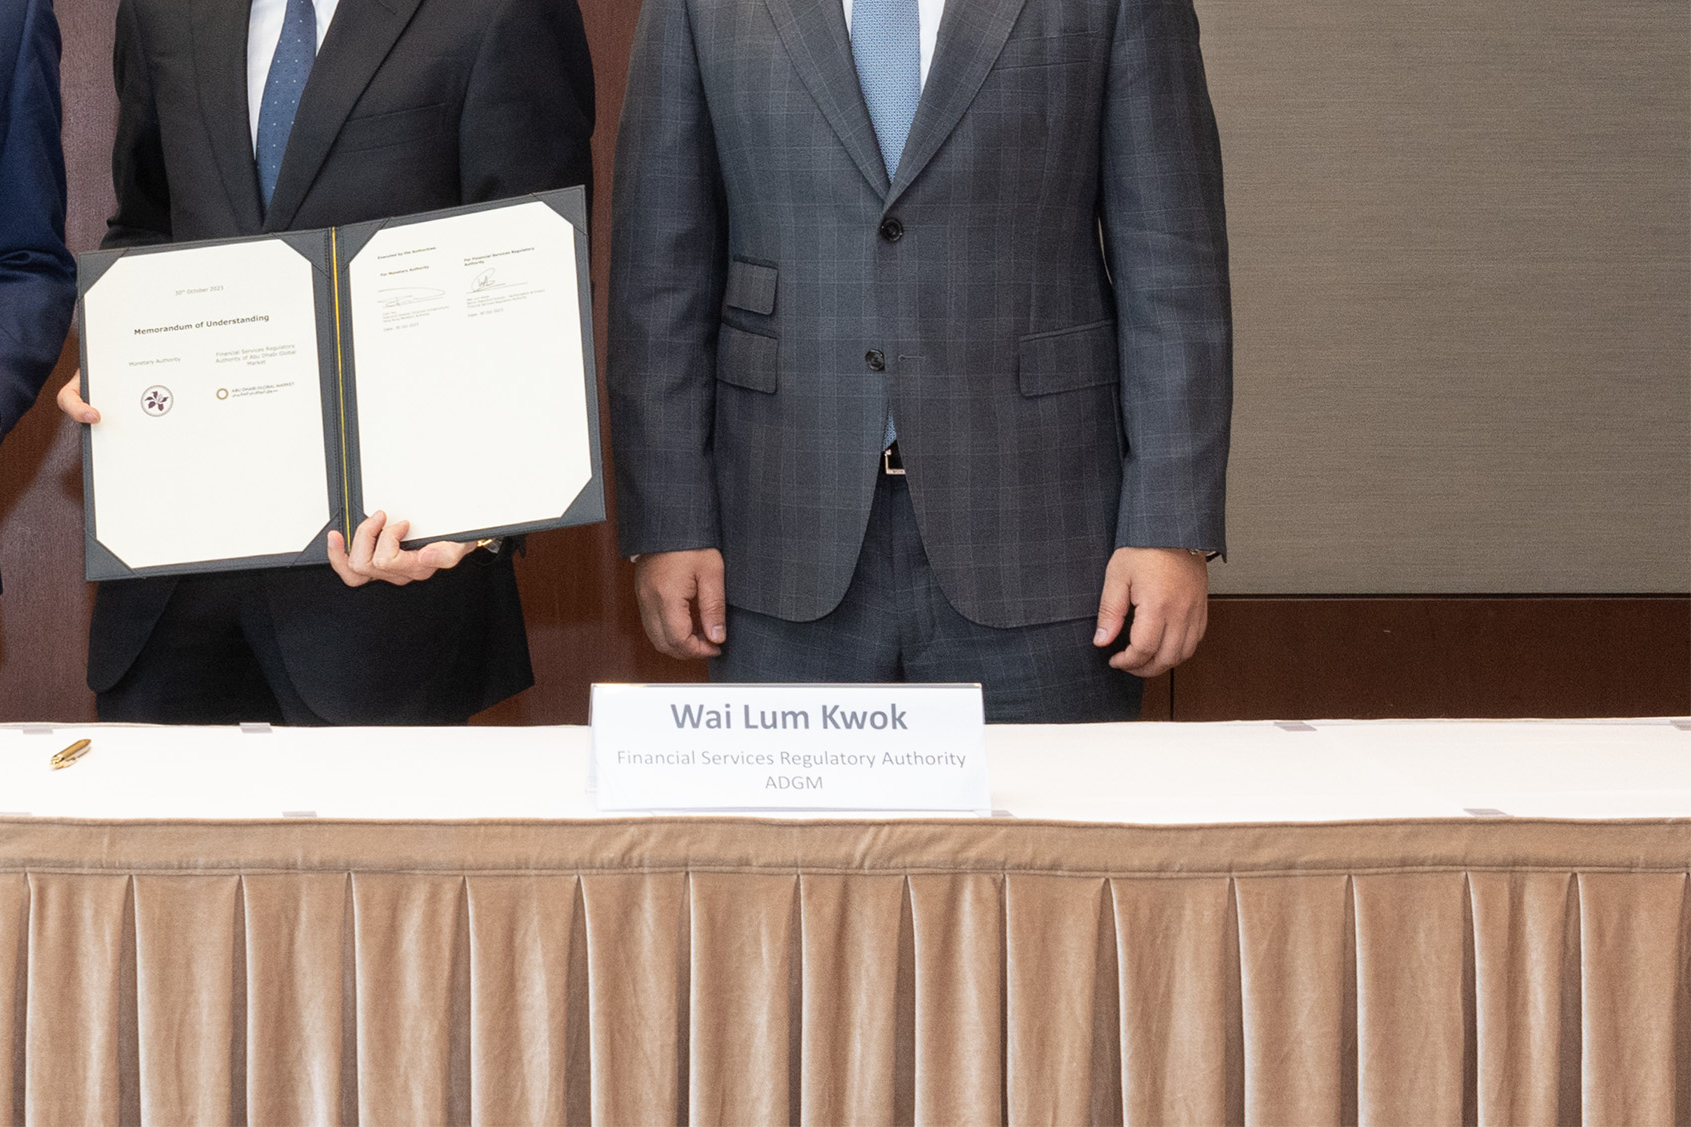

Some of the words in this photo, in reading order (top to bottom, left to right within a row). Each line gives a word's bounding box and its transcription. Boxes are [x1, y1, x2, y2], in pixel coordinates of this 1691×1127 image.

[186, 287, 209, 295] October
[134, 323, 193, 335] Memorandum
[195, 321, 204, 329] of
[205, 315, 270, 327] Understanding
[128, 359, 154, 367] Monetary
[155, 357, 181, 365] Authority
[671, 704, 731, 729] Wai
[744, 704, 810, 729] Lum
[822, 704, 908, 730] Kwok
[617, 750, 696, 766] Financial
[702, 750, 774, 766] Services
[781, 750, 876, 769] Regulatory
[882, 751, 967, 768] Authority
[765, 775, 824, 790] ADGM
